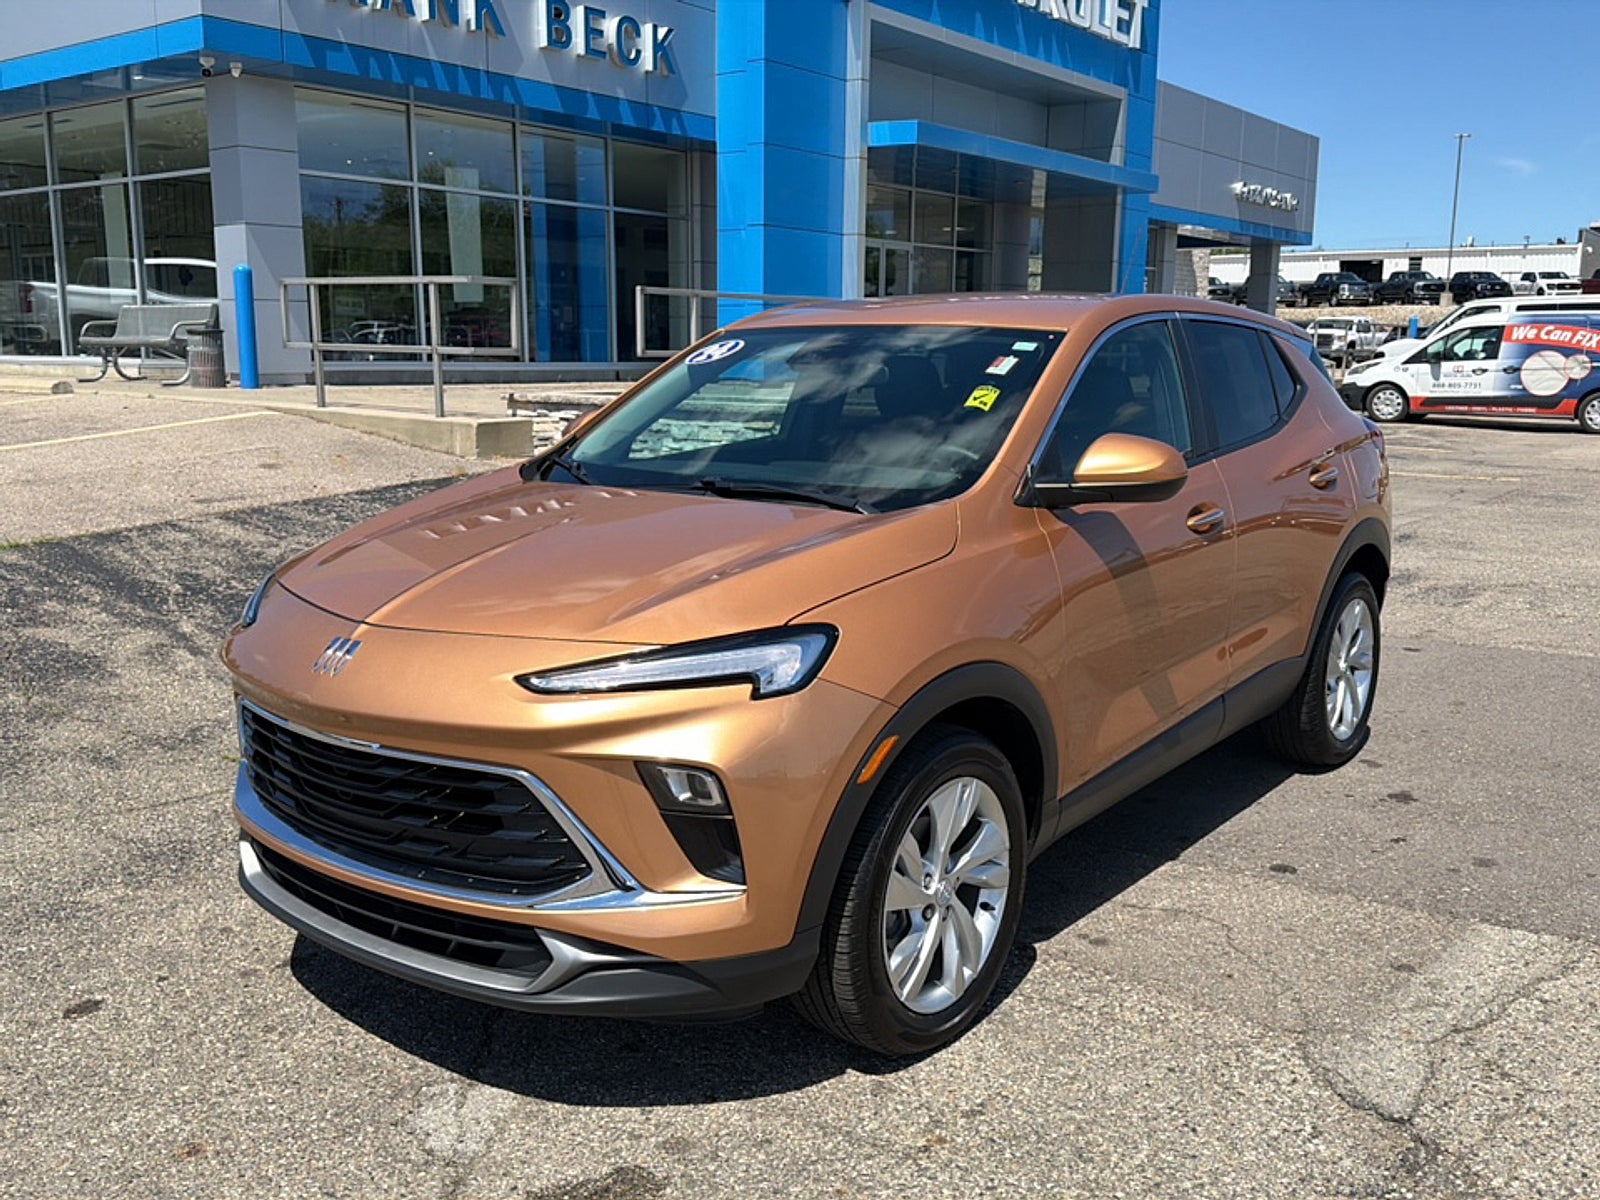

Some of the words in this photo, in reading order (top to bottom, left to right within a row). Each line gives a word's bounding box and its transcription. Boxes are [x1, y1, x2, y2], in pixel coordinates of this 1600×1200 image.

[538, 0, 676, 77] BECK
[1511, 326, 1538, 341] We
[1540, 325, 1573, 341] Can
